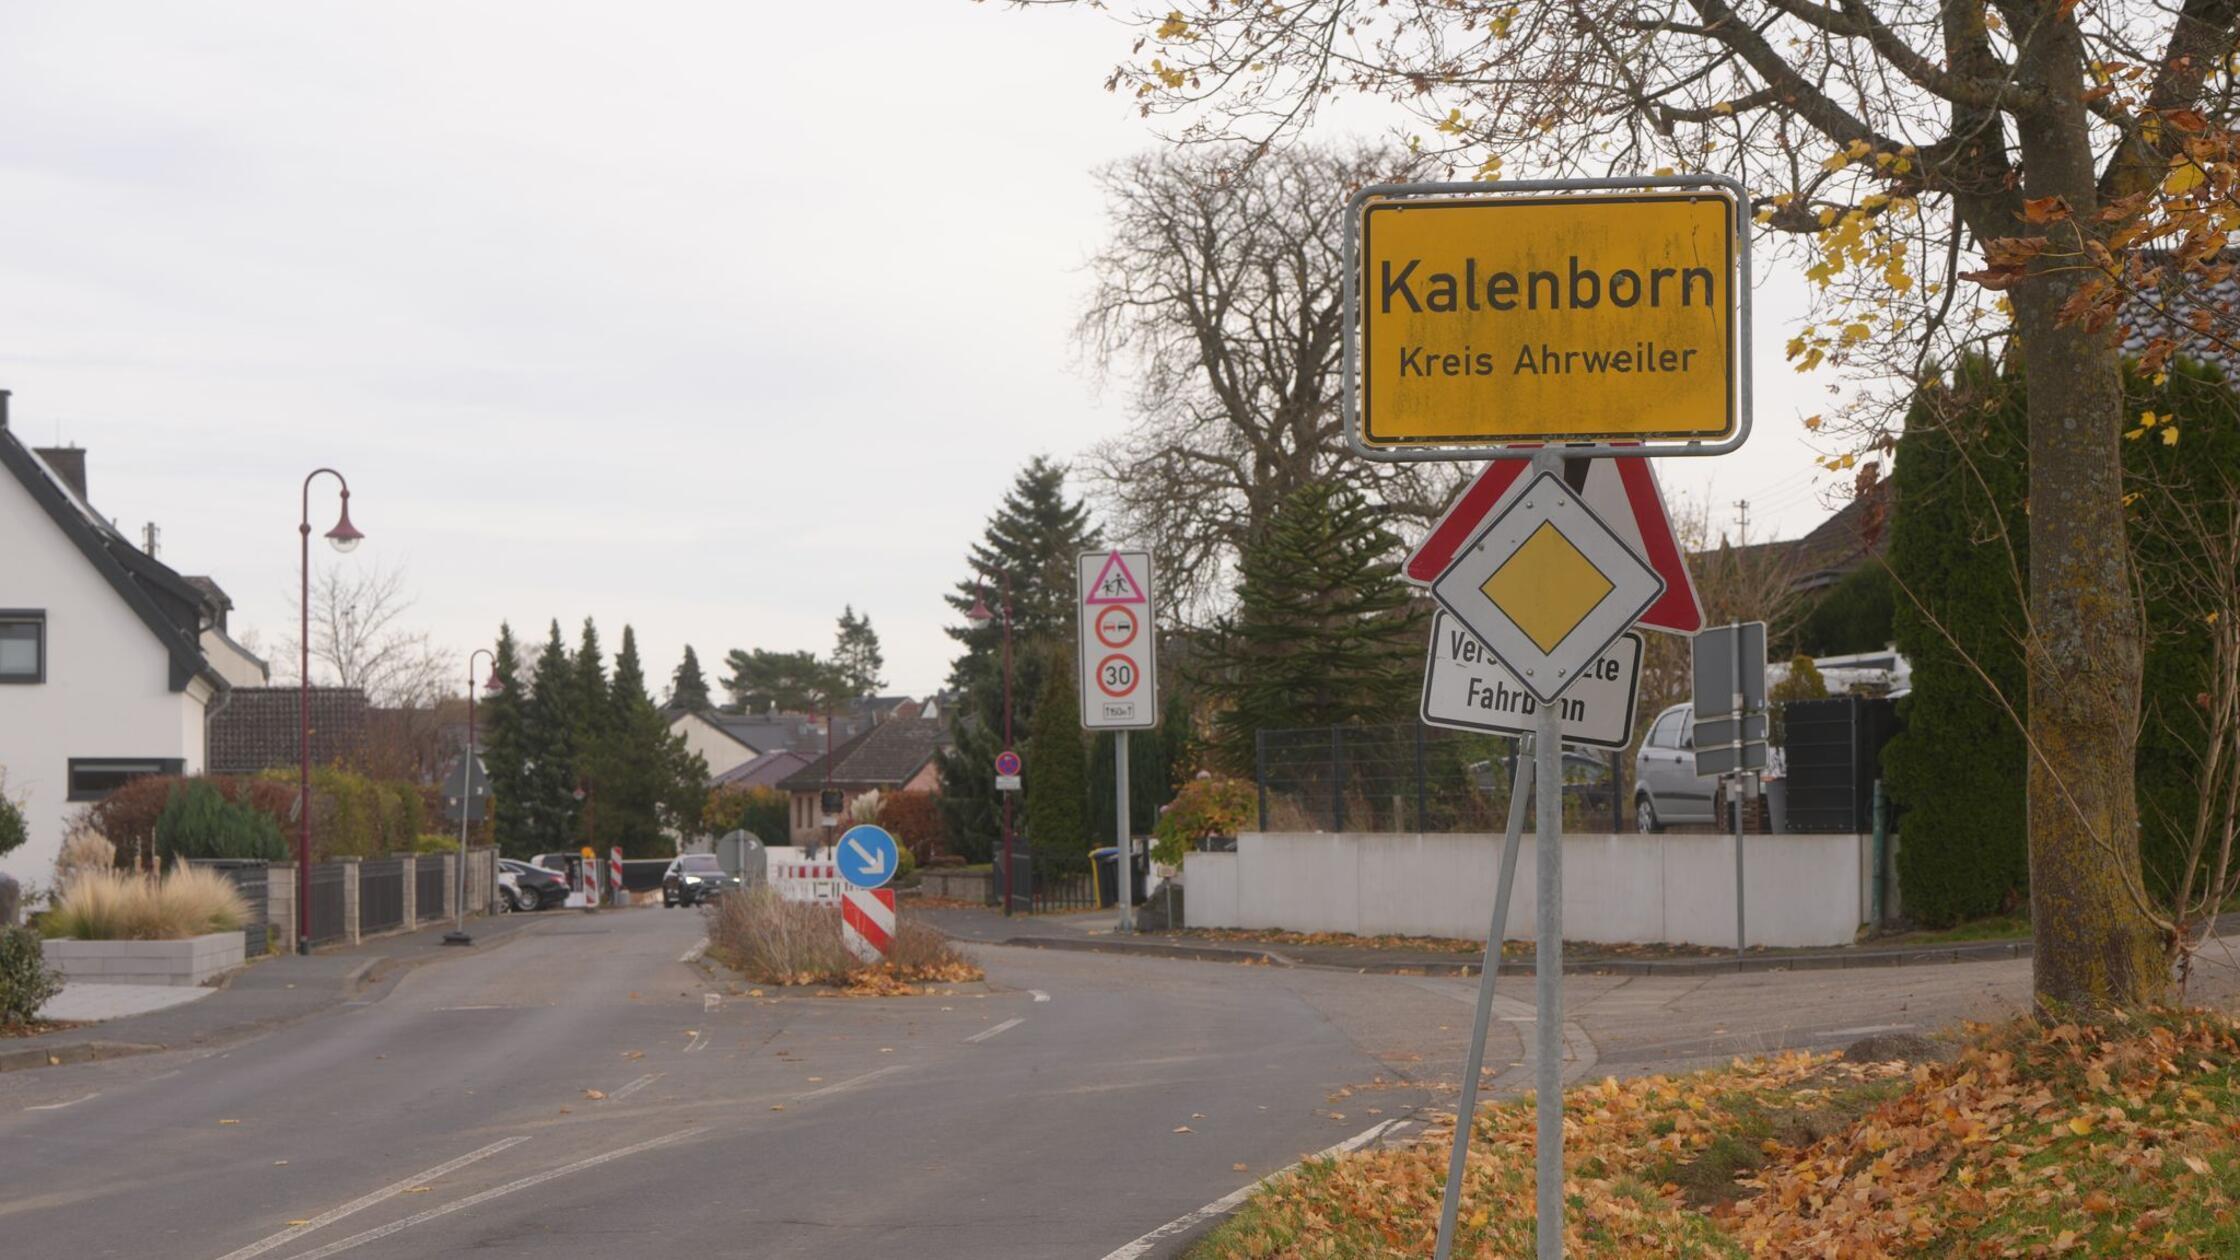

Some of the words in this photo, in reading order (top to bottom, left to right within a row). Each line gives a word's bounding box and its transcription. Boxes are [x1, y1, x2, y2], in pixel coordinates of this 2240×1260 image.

[1382, 256, 1714, 314] Kalenborn
[1400, 346, 1494, 377] Kreis
[1514, 342, 1698, 375] Ahrweiler
[1105, 665, 1130, 686] 30
[1467, 677, 1585, 722] Fahrbn
